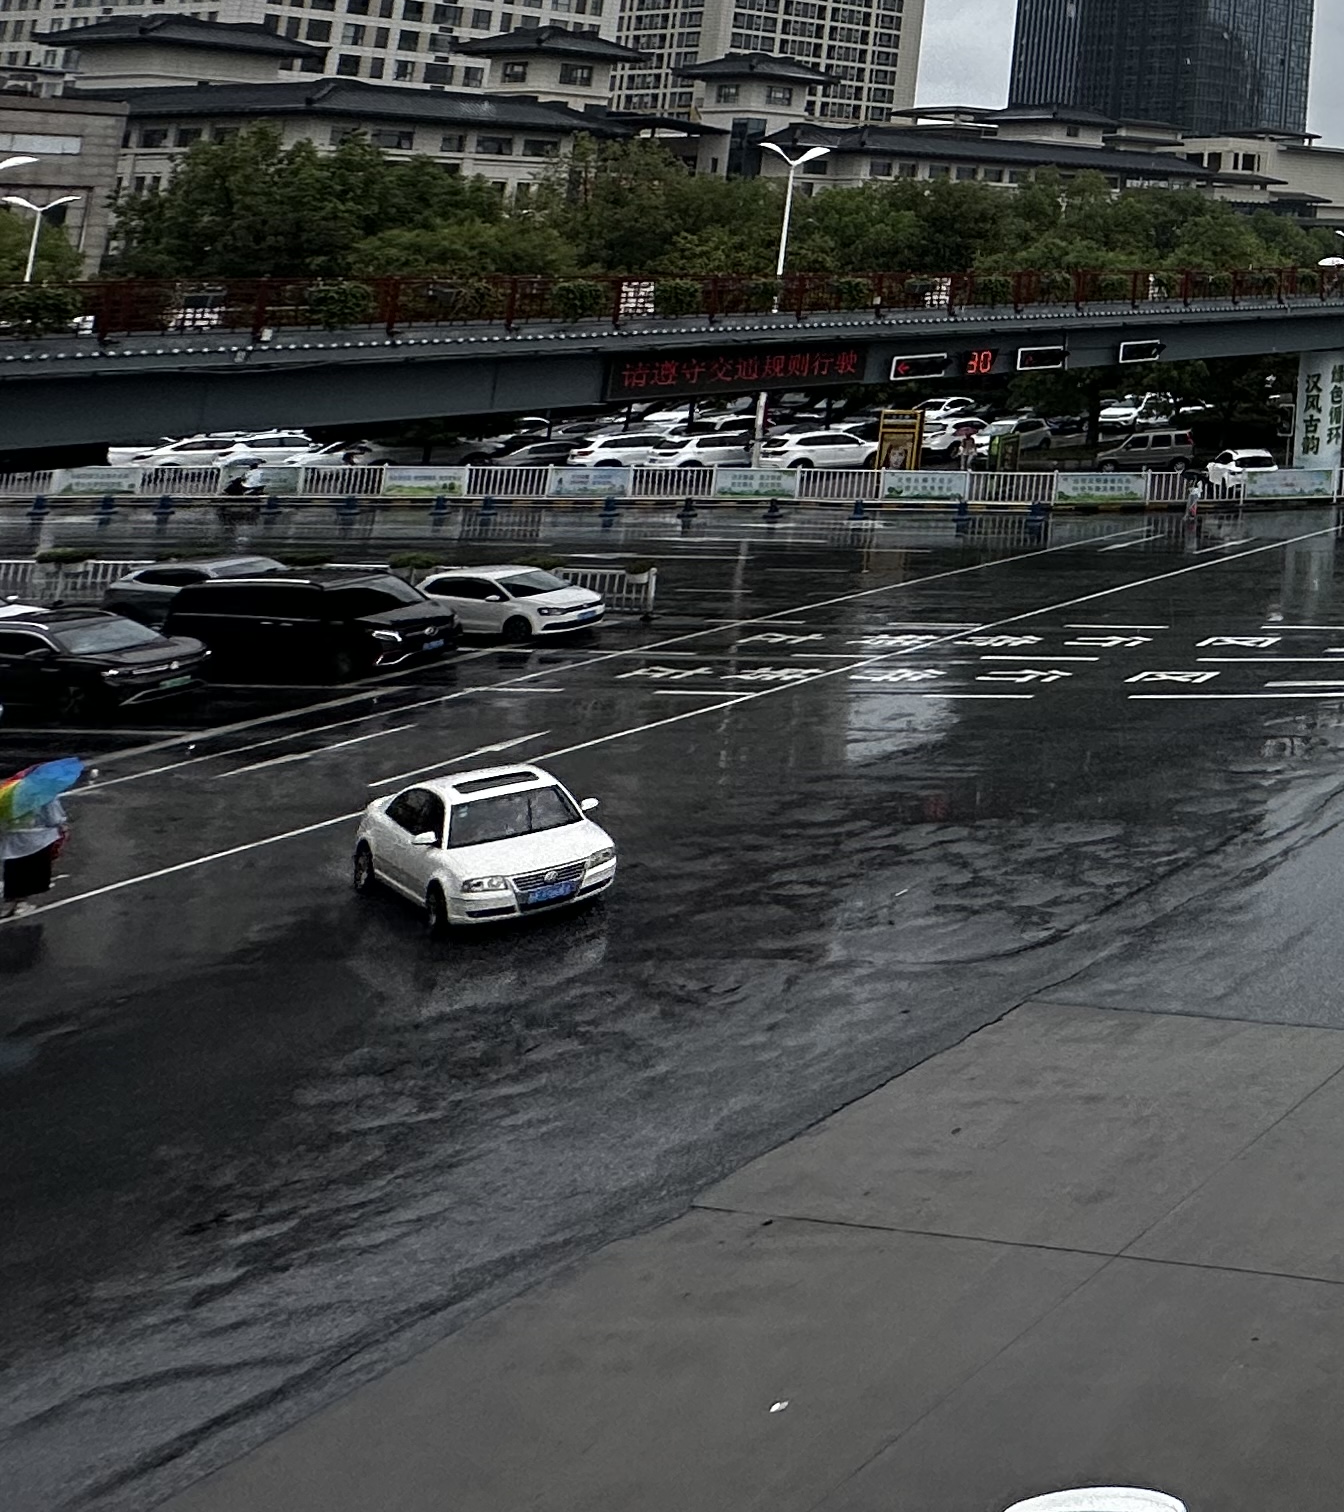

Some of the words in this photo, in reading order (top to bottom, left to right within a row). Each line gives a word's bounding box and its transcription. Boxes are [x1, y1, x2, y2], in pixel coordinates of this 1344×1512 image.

[621, 351, 858, 388] 请遵守交通规则行驶
[966, 351, 993, 376] 30
[1302, 373, 1323, 455] 汉风古韵
